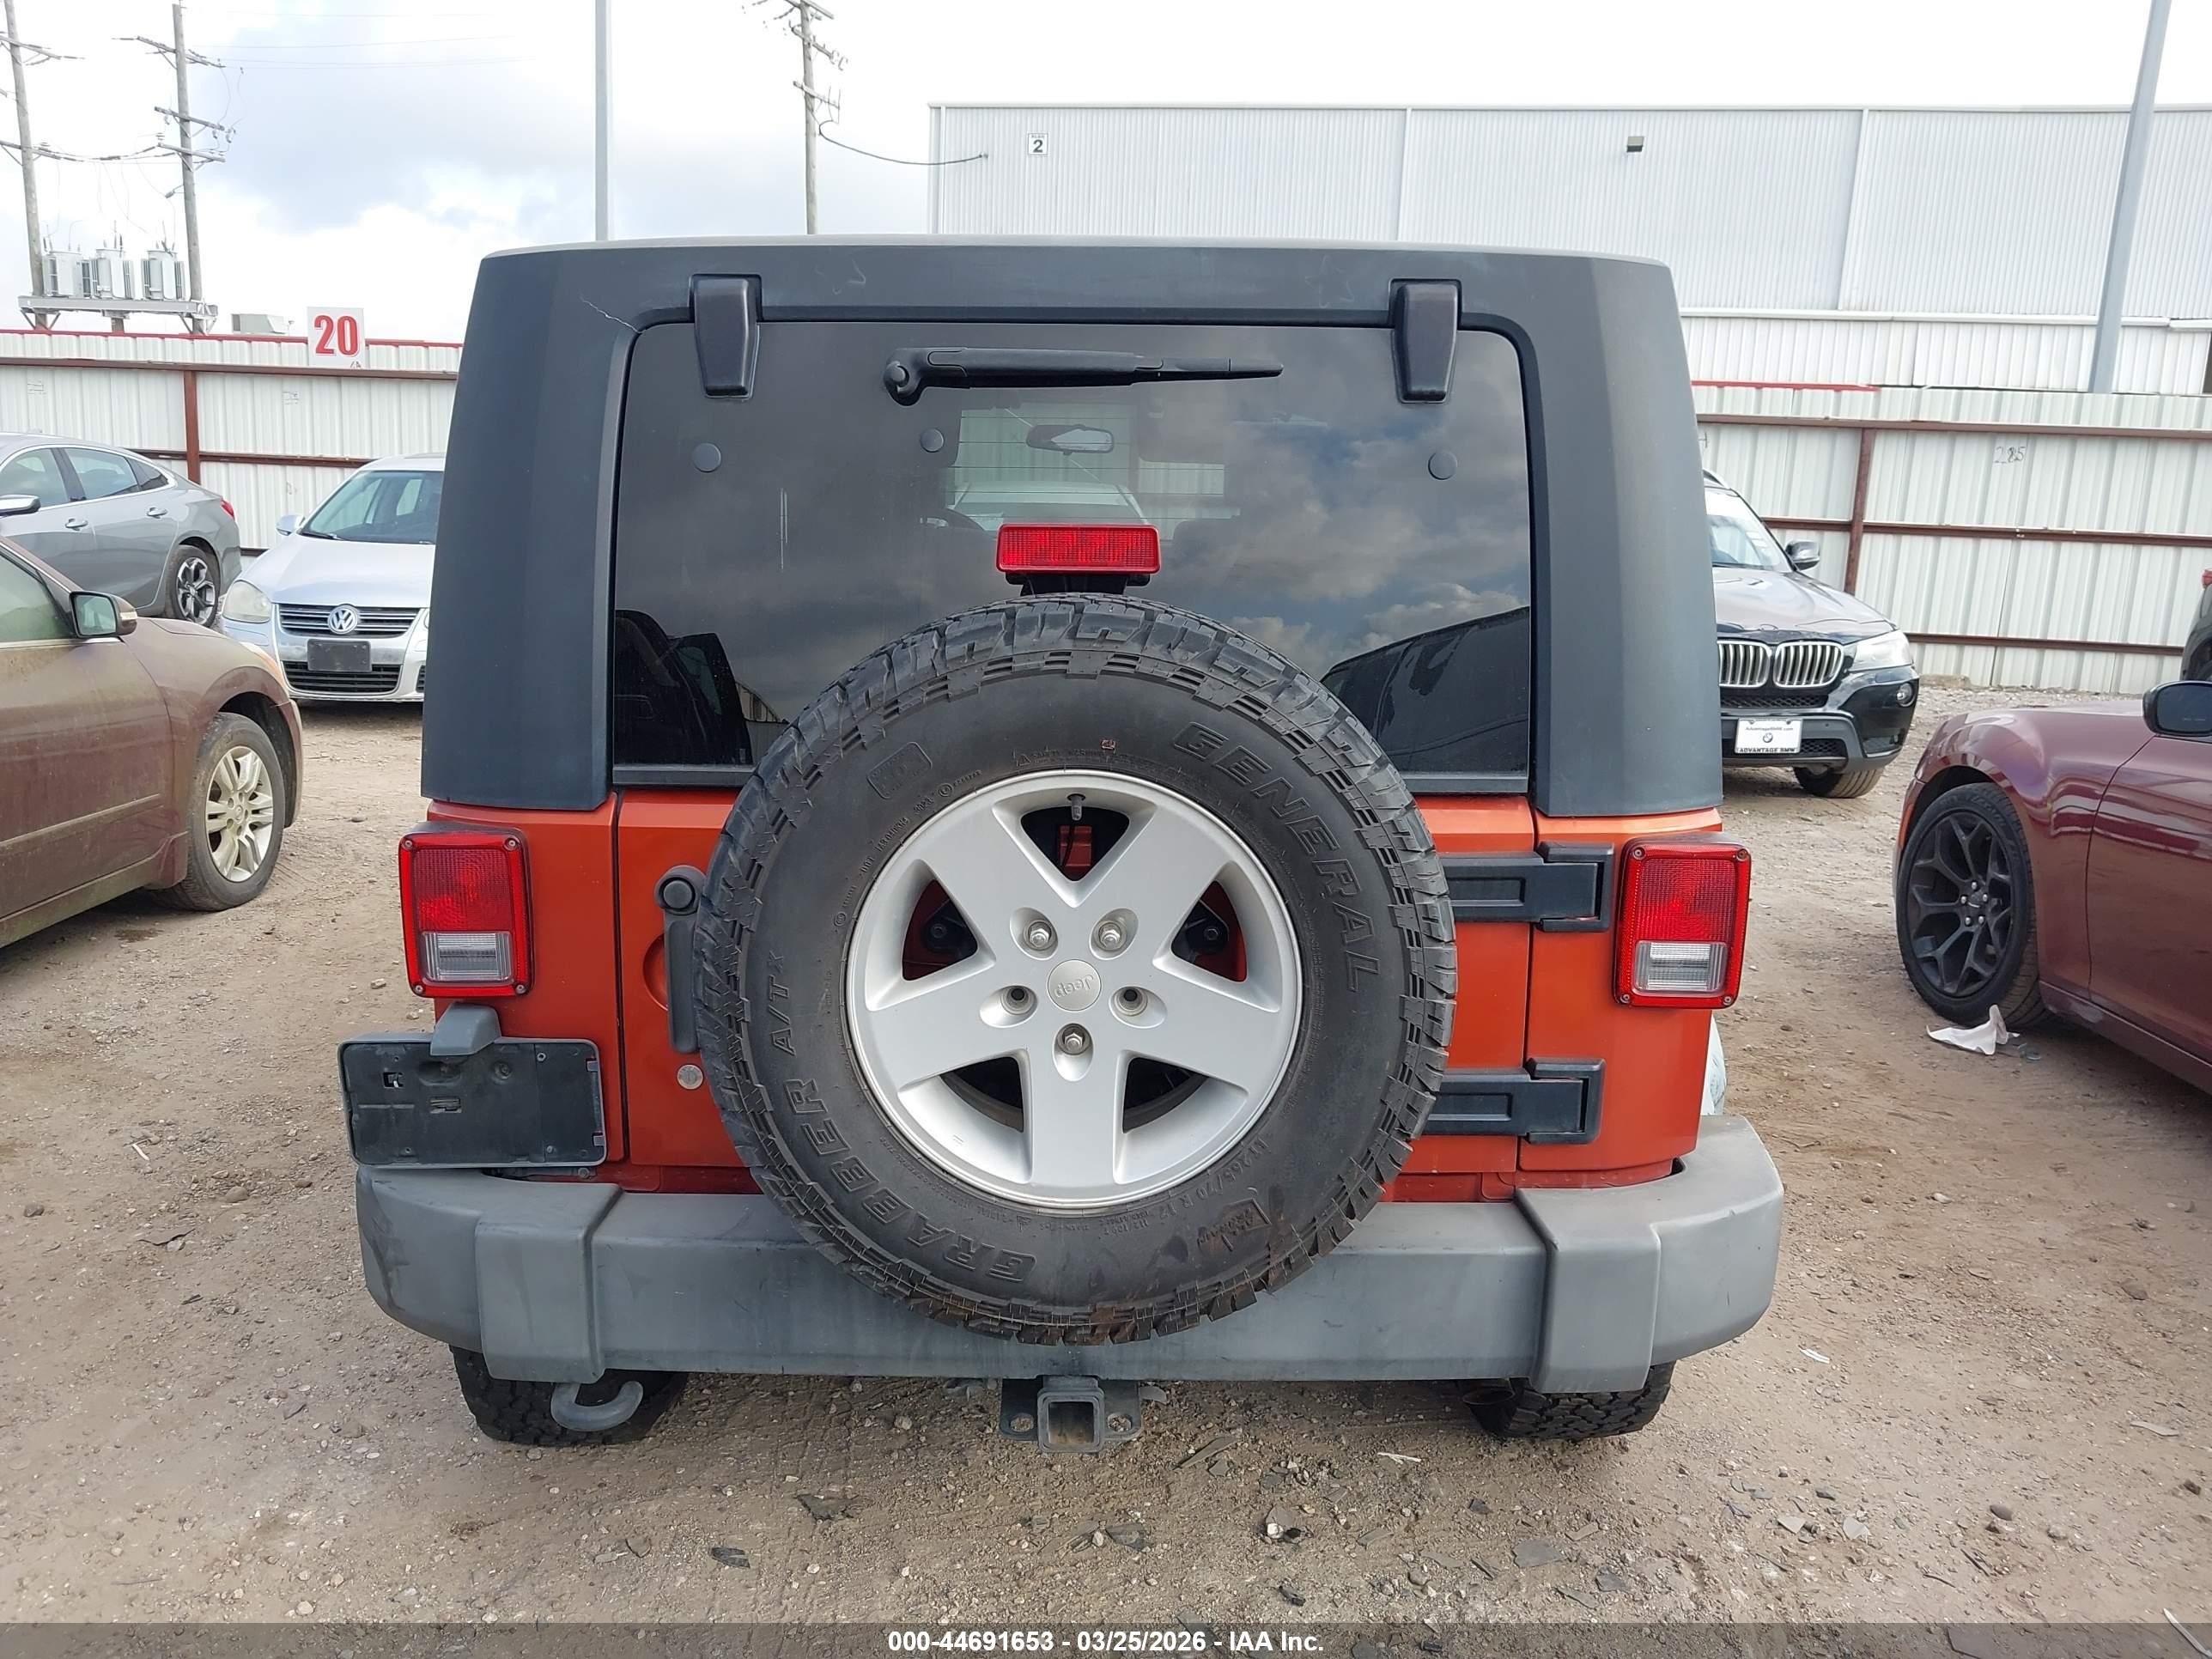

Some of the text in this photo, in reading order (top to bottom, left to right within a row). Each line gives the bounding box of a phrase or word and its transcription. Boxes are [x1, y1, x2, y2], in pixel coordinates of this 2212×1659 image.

[1033, 138, 1043, 154] 2
[313, 314, 359, 356] 20
[1172, 721, 1380, 992] GENERAL
[1054, 974, 1094, 998] Jeep
[784, 1078, 1036, 1282] GRABBER
